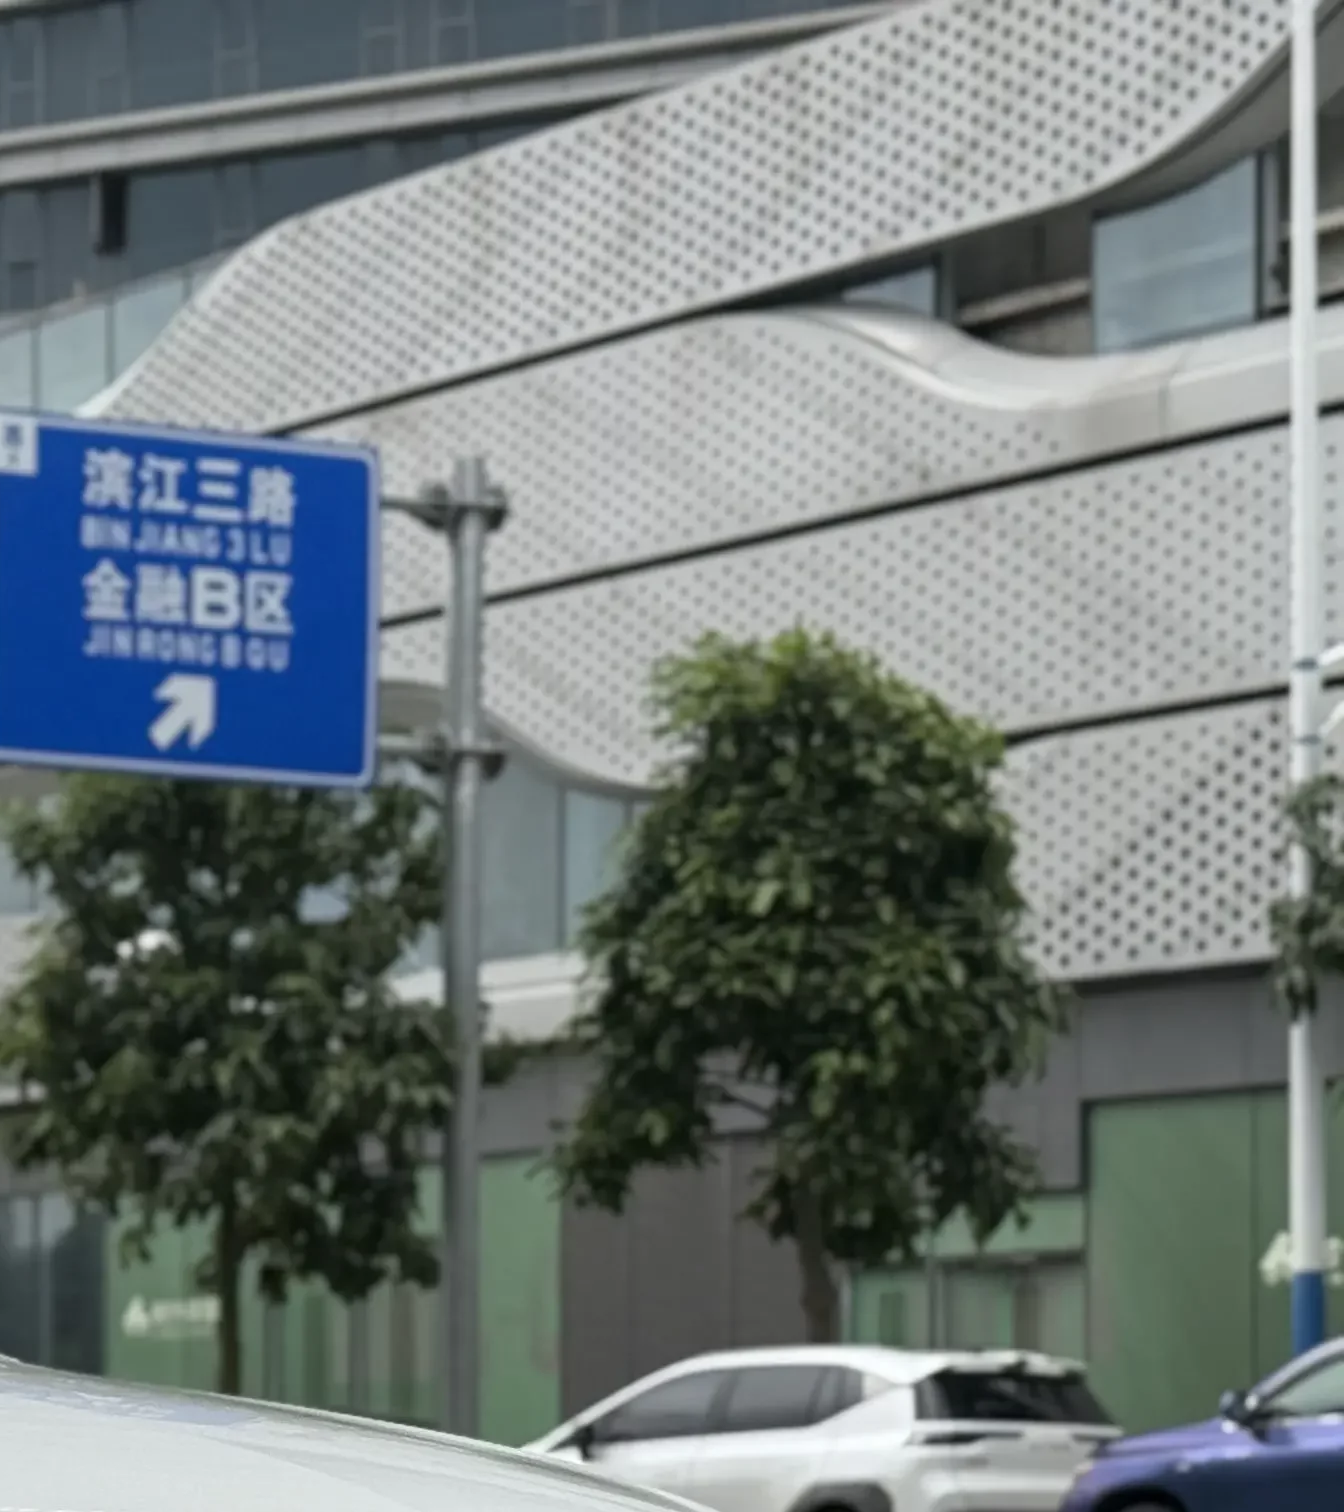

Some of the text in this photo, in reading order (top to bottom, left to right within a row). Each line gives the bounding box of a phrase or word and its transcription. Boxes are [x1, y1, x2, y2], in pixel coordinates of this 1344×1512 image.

[82, 447, 296, 526] 滨江三路
[80, 514, 131, 549] BIN
[249, 528, 292, 566] LU
[81, 557, 295, 634] 金融B区
